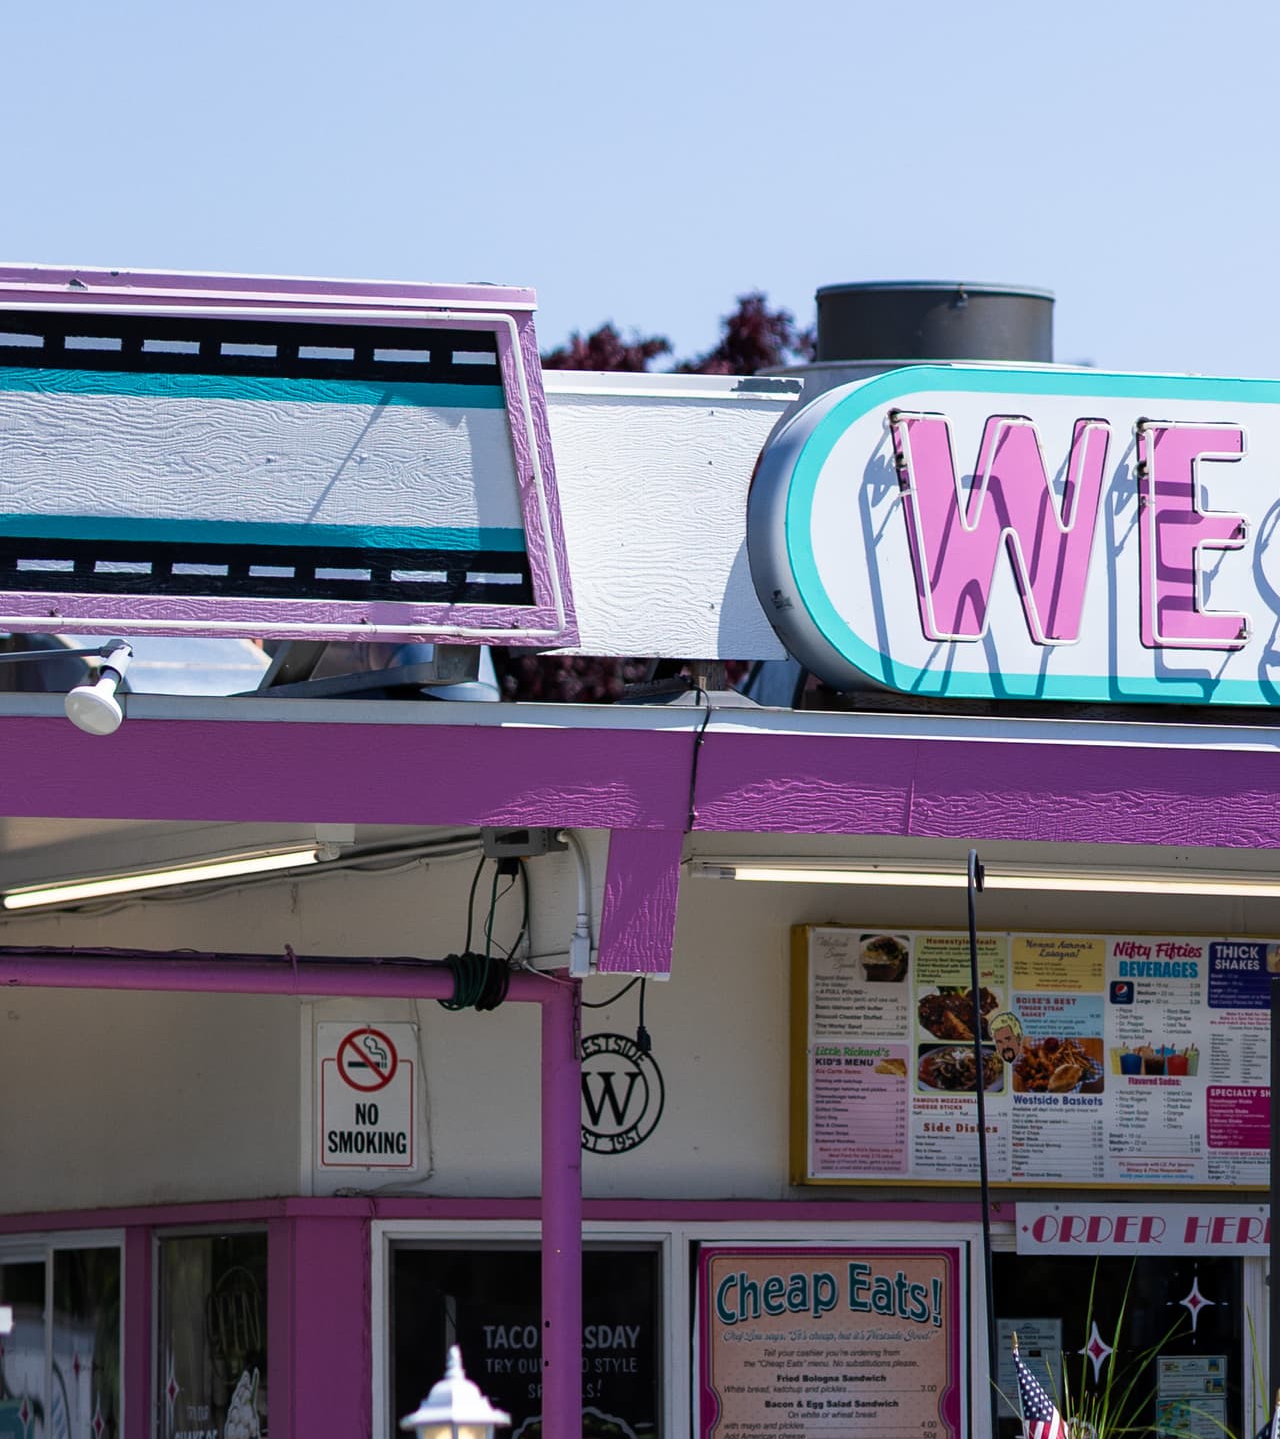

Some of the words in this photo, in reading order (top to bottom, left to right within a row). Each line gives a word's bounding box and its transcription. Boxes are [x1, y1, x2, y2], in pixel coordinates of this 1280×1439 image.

[1113, 941, 1151, 960] Nifty
[1155, 942, 1203, 960] Fifties
[1215, 946, 1259, 959] THICK
[1118, 960, 1199, 978] BEVERAGES
[1215, 960, 1260, 970] SHAKES
[582, 1036, 646, 1063] ESTSIDE
[815, 1058, 842, 1066] KID'S
[845, 1059, 874, 1067] MENU
[581, 1071, 643, 1127] W
[1013, 1094, 1060, 1105] Westside
[1062, 1096, 1104, 1106] Baskets
[355, 1102, 379, 1126] NO
[923, 1122, 951, 1133] Side
[956, 1123, 998, 1134] Dises
[328, 1129, 407, 1155] SMOKING
[1032, 1215, 1167, 1244] ORDER
[1183, 1216, 1270, 1244] HER
[716, 1271, 840, 1325] Cheap
[847, 1260, 943, 1328] Eats!
[483, 1325, 539, 1350] TACO
[582, 1325, 641, 1350] SDAY
[485, 1358, 514, 1373] TRY
[594, 1358, 639, 1373] STYLE
[776, 1375, 800, 1384] Fried
[802, 1375, 839, 1384] Bologna
[842, 1375, 887, 1384] Sandwich
[804, 1385, 819, 1394] and
[765, 1401, 794, 1410] Bacon
[797, 1401, 804, 1410] &
[806, 1401, 824, 1410] Egg
[826, 1401, 852, 1410] Salad
[854, 1401, 899, 1410] Sandwich
[763, 1422, 776, 1431] and
[921, 1422, 937, 1431] 4.00
[724, 1432, 739, 1439] Add
[740, 1432, 777, 1439] American
[778, 1432, 806, 1439] cheese
